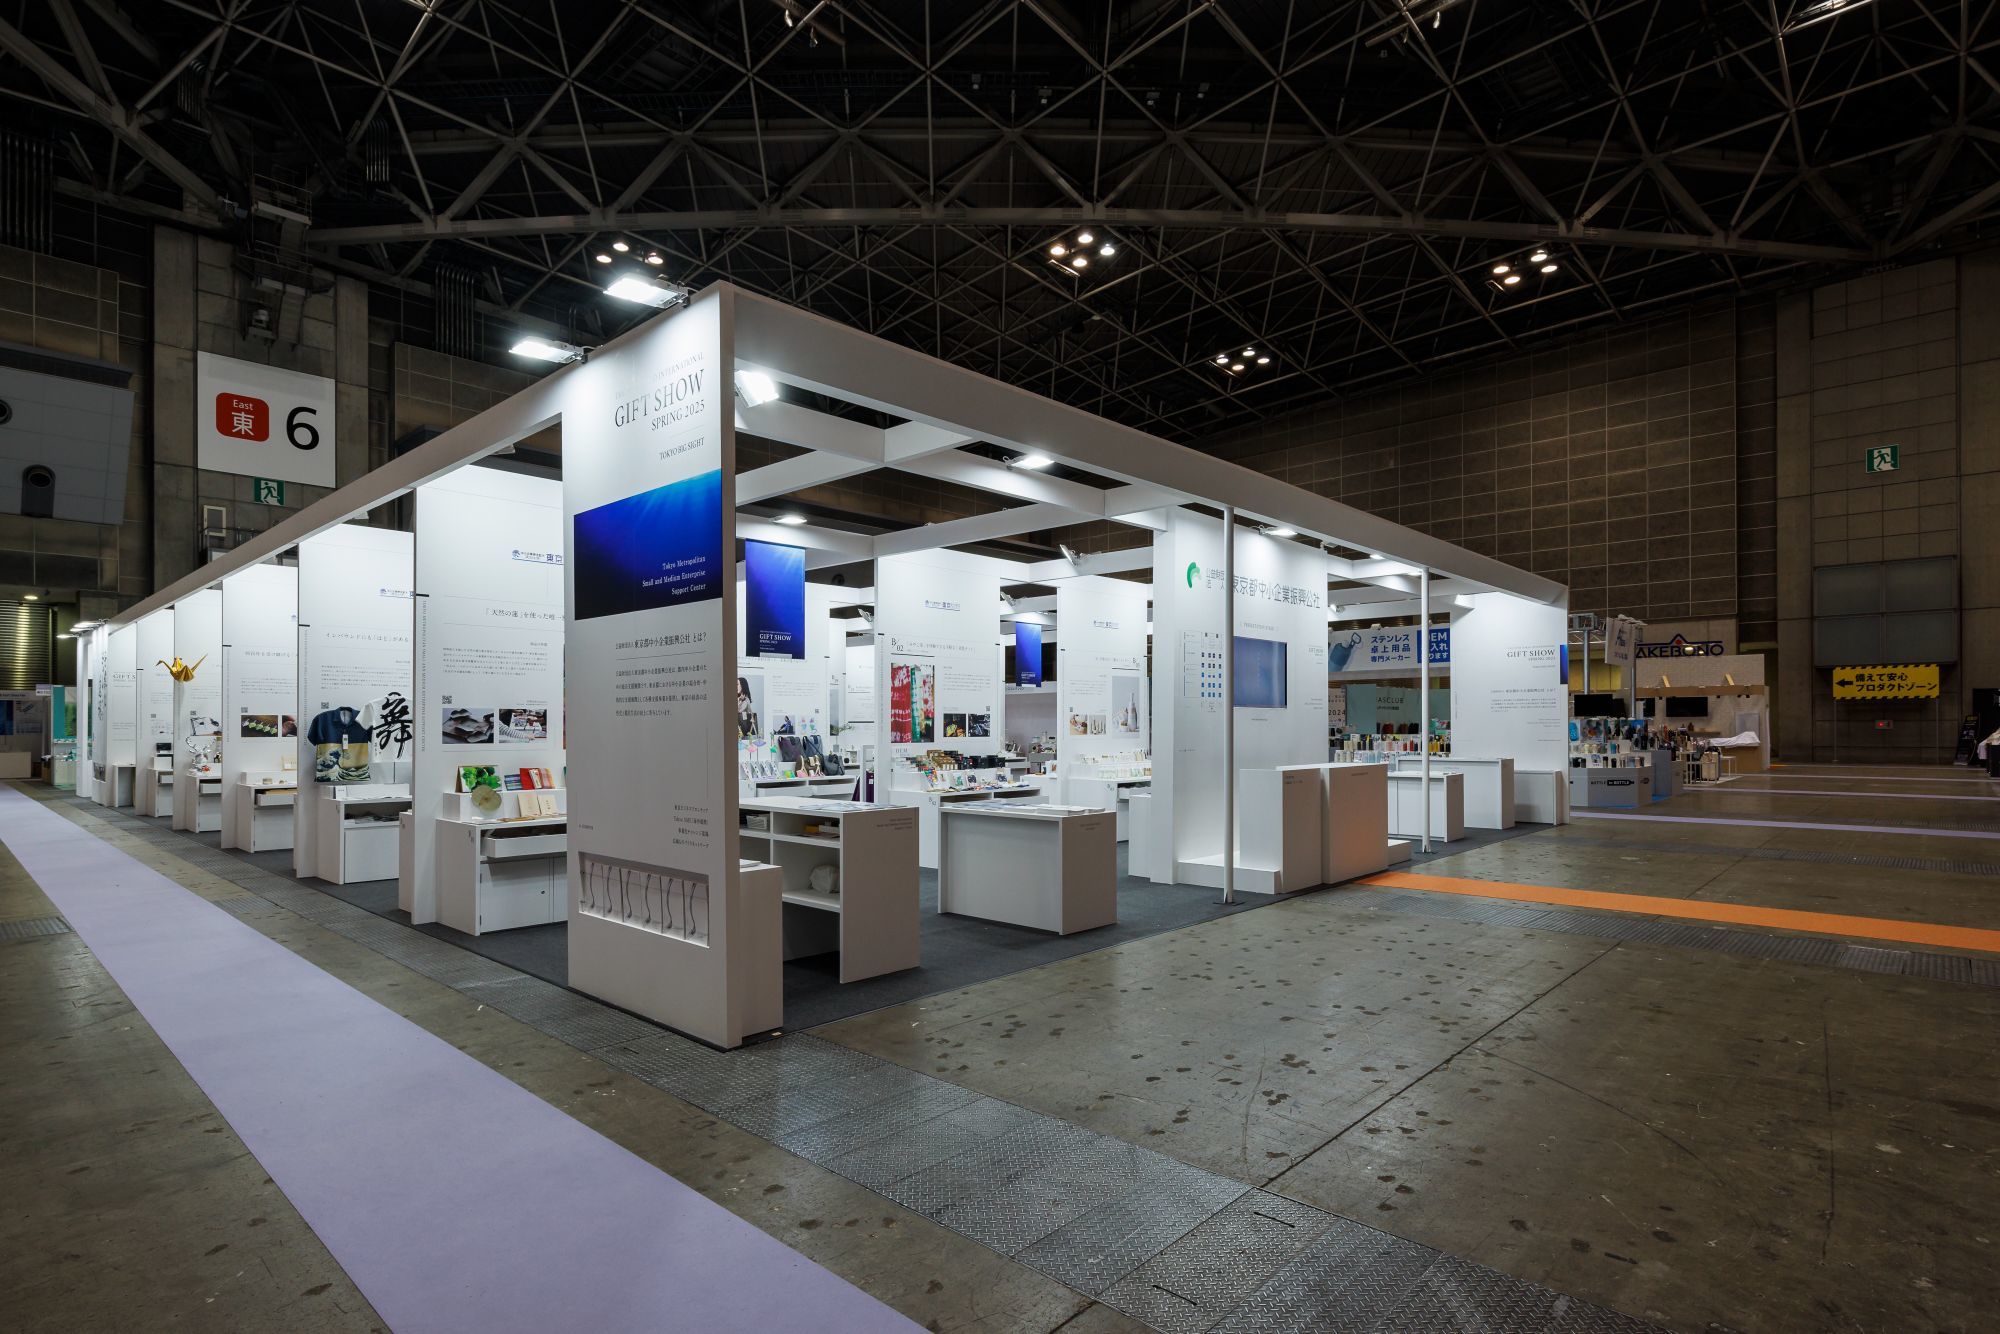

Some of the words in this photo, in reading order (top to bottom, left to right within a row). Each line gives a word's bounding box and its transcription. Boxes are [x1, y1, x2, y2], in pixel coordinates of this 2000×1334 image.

[233, 399, 254, 410] East
[615, 393, 650, 427] GIFT
[654, 369, 704, 412] SHOW
[651, 407, 683, 431] SPRING
[684, 399, 705, 418] 2025
[231, 411, 255, 436] 東
[286, 406, 319, 450] 6
[662, 562, 676, 571] Tokyo
[676, 555, 706, 568] Metropolitan
[642, 578, 654, 587] Small
[654, 576, 663, 585] and
[663, 573, 681, 584] Medium
[681, 569, 706, 580] Enterprise
[671, 584, 690, 596] Support
[690, 582, 706, 592] Center
[1370, 634, 1410, 644] ステンレス
[1370, 644, 1411, 653] 卓上用品
[1529, 649, 1556, 657] SHOW
[1635, 644, 1724, 659] AKEBONO
[1855, 672, 1908, 682] 備えて安心
[1855, 682, 1938, 692] プロダクトゾーン
